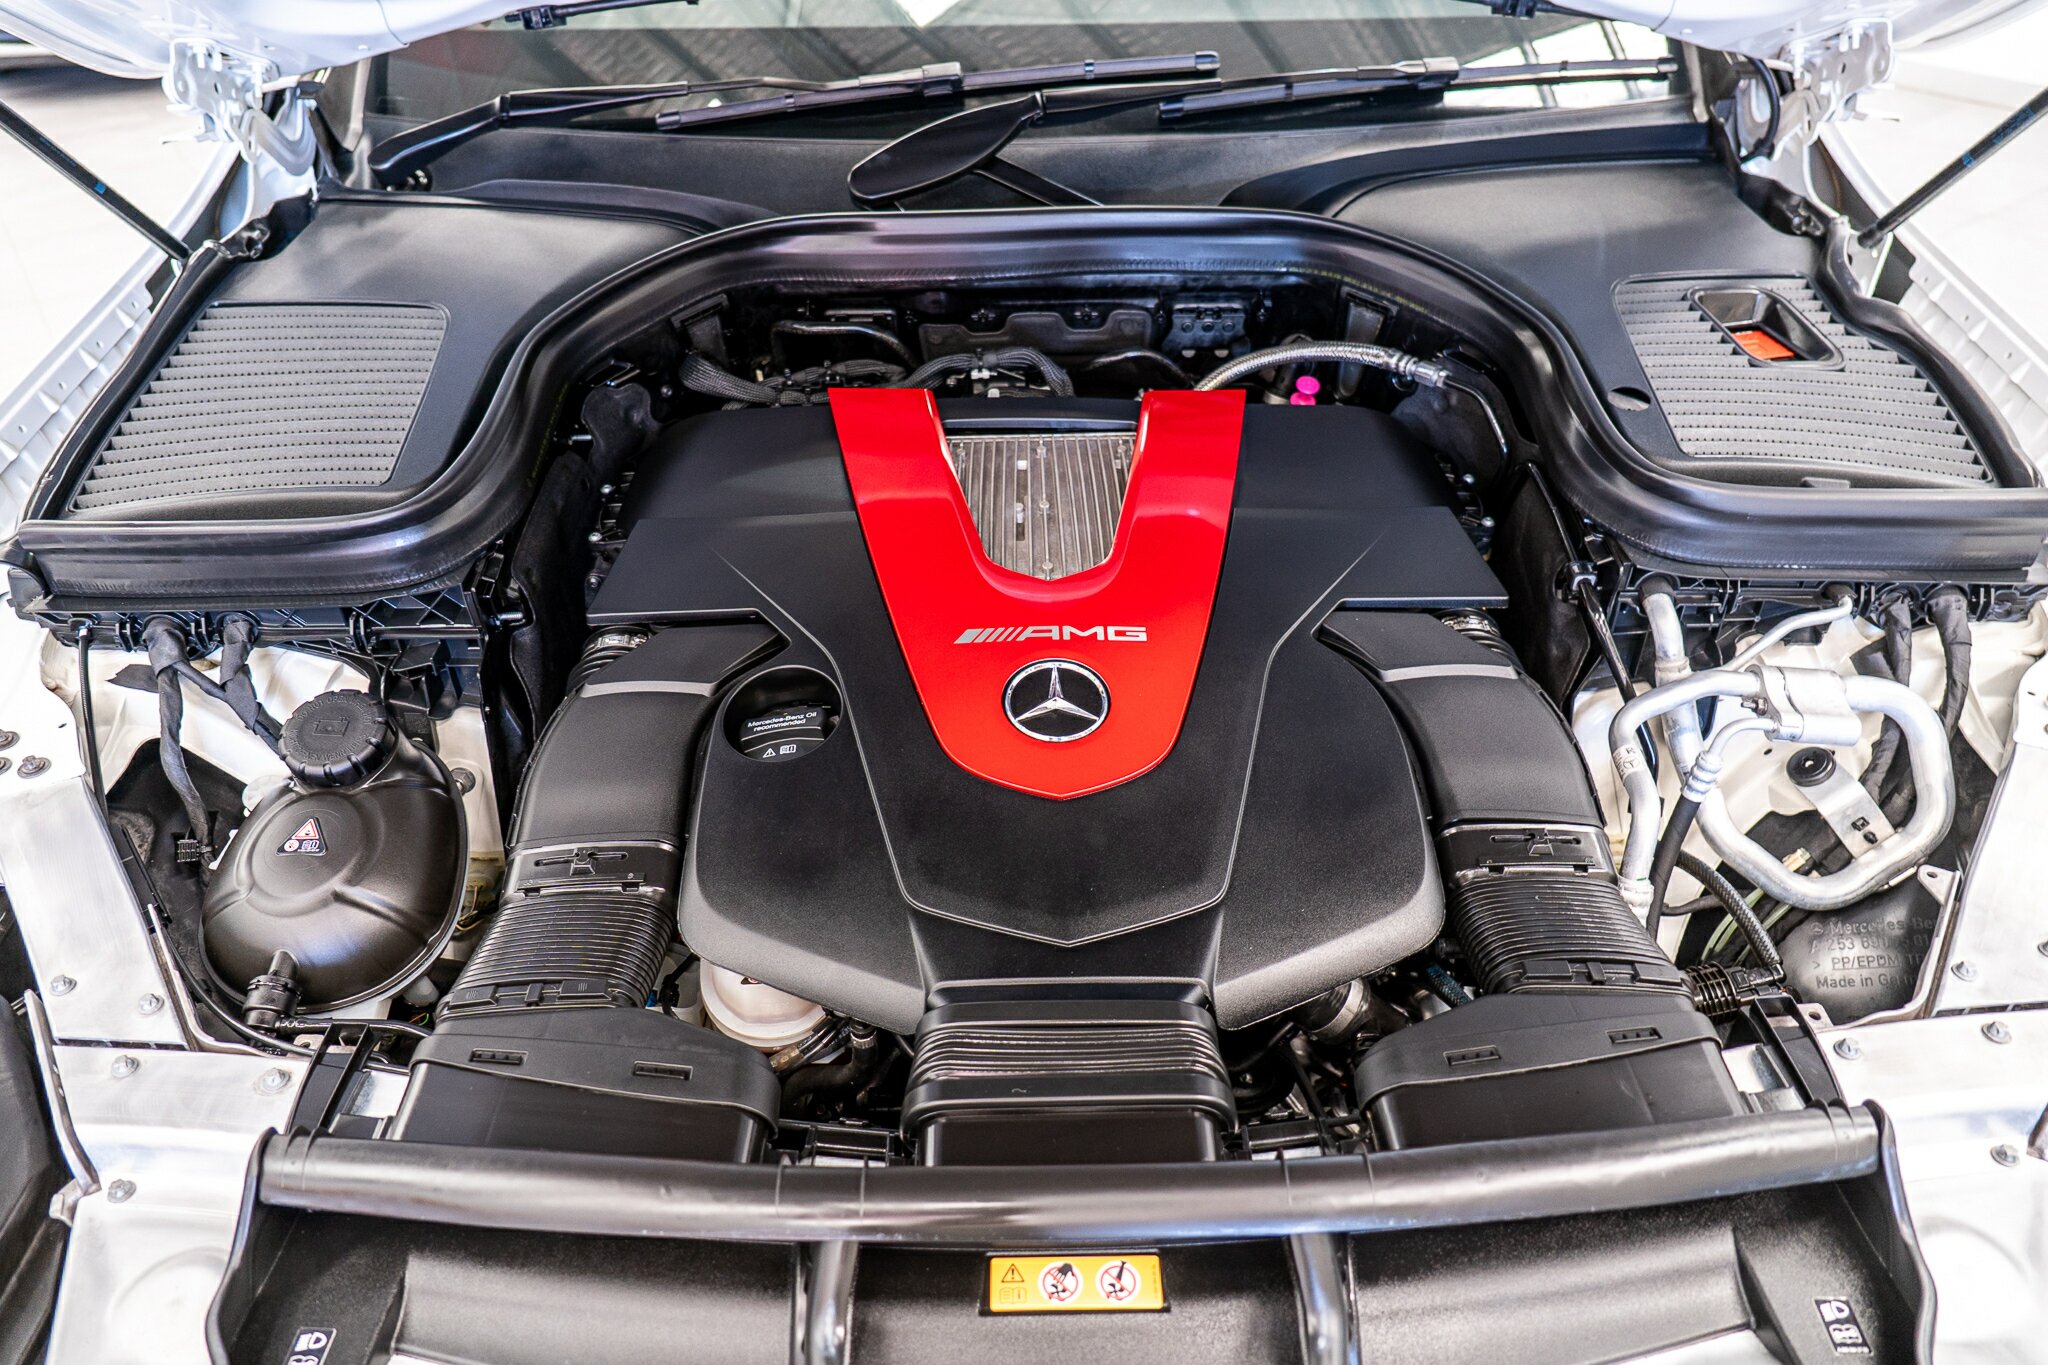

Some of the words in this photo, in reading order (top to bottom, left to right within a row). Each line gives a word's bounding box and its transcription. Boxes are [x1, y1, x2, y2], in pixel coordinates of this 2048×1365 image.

[1016, 625, 1148, 642] AMG
[747, 714, 804, 728] Mercedes-Benz
[753, 718, 807, 732] recommended
[1827, 937, 1855, 951] 253
[1831, 955, 1900, 969] PP/EPDM
[1816, 974, 1856, 990] Made
[1860, 974, 1874, 987] in
